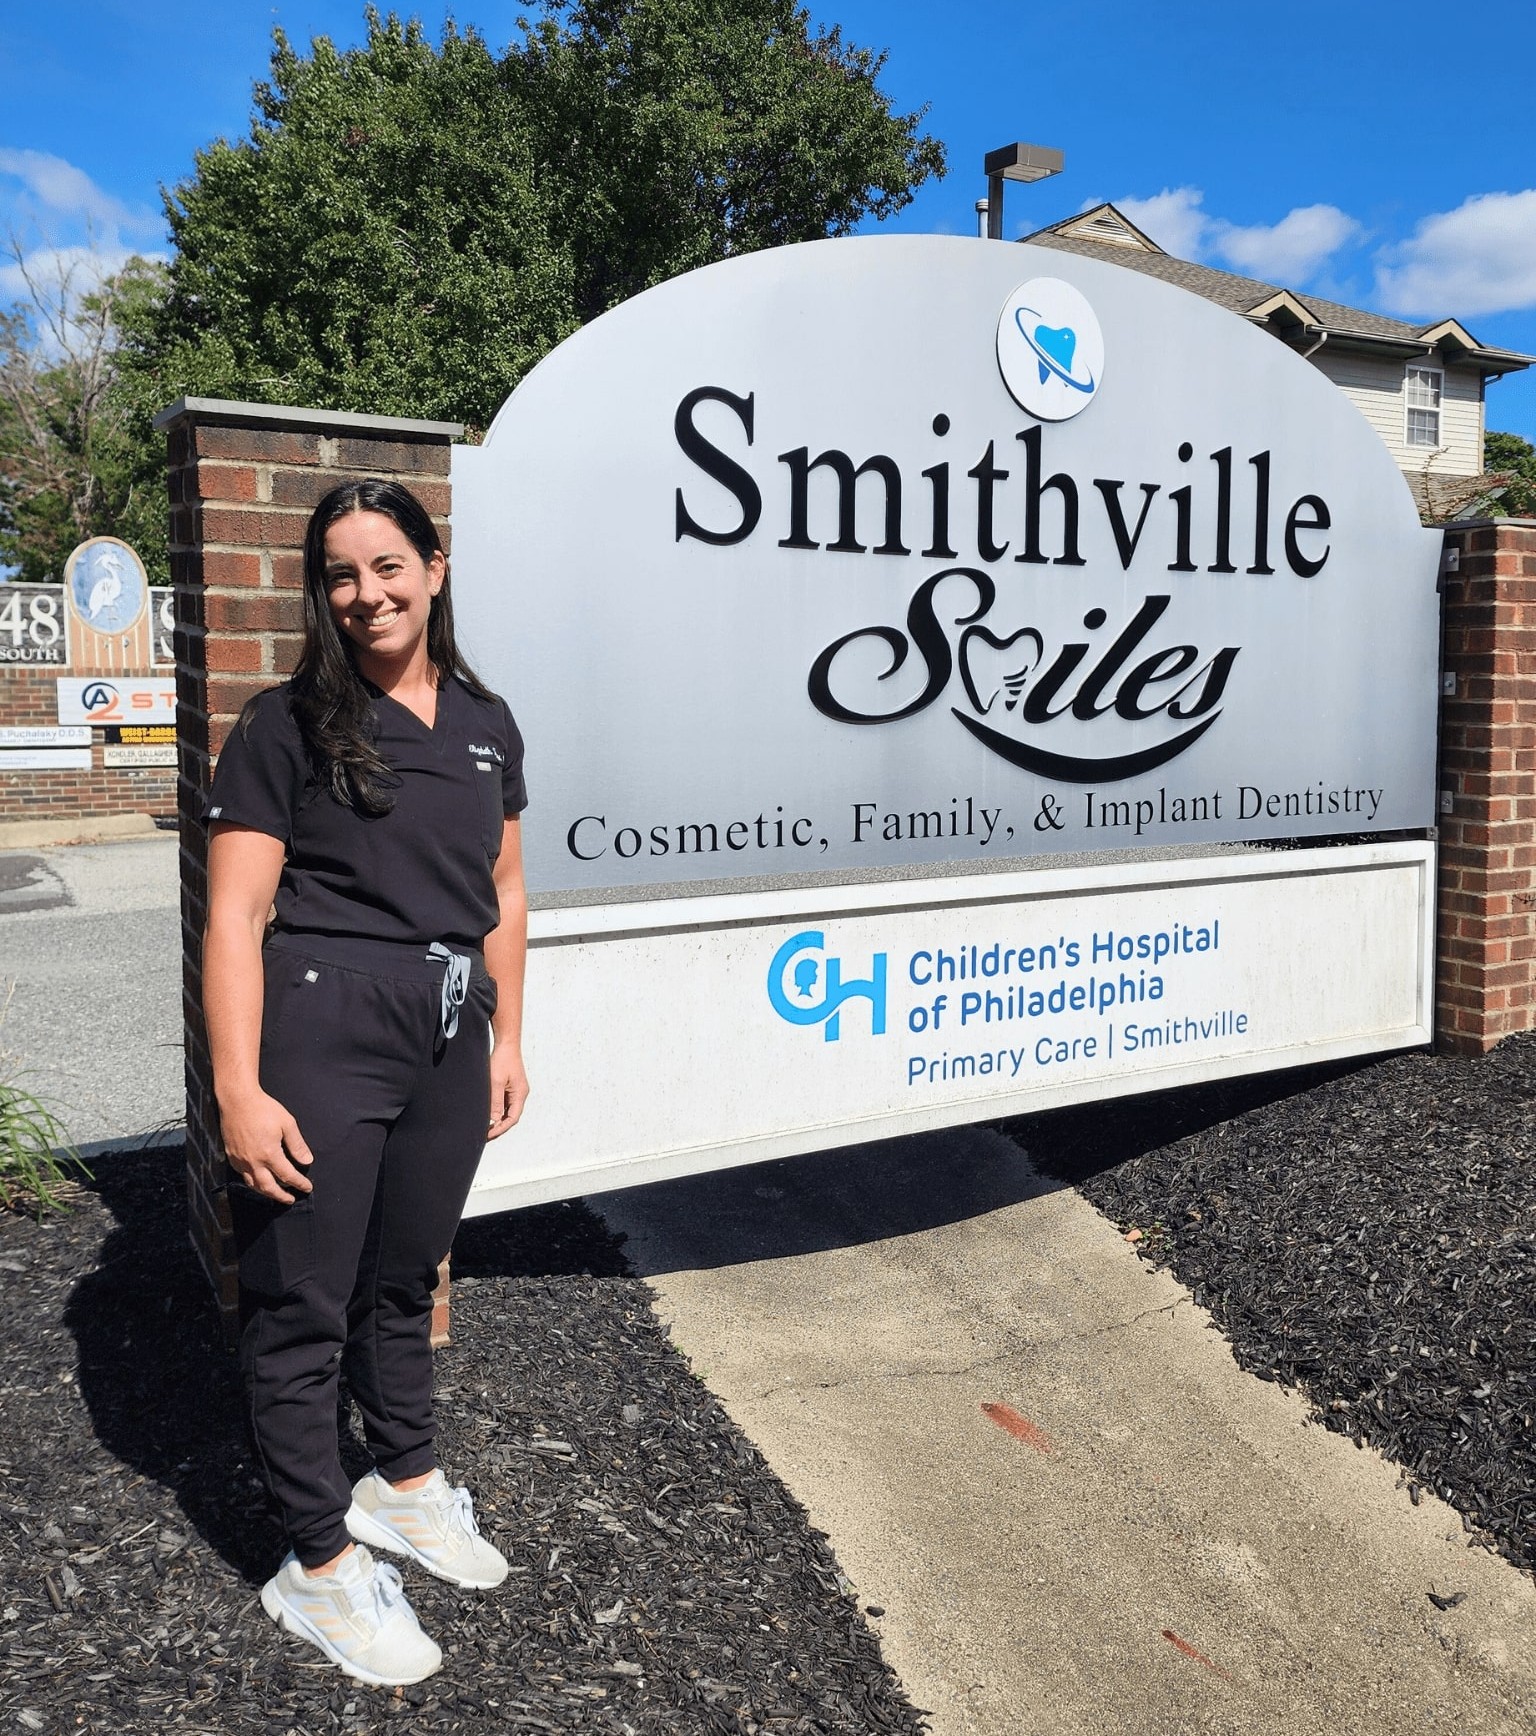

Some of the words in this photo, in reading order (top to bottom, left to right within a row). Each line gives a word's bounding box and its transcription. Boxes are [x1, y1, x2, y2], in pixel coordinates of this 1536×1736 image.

[674, 386, 1331, 579] Smithville
[0, 648, 60, 661] SOUTH
[807, 567, 1241, 725] Smiles
[566, 806, 829, 861] Cosmetic,
[850, 796, 1014, 846] Family,
[1033, 793, 1066, 832] &
[1085, 788, 1223, 836] Implant
[1237, 782, 1384, 821] Dentistry
[908, 936, 1081, 986] Children's
[1092, 920, 1219, 964] Hospital
[908, 992, 947, 1033] of
[961, 972, 1165, 1027] Philadelphia
[908, 1045, 1025, 1086] Primary
[1035, 1036, 1097, 1067] Care
[1123, 1010, 1249, 1052] Smithville
